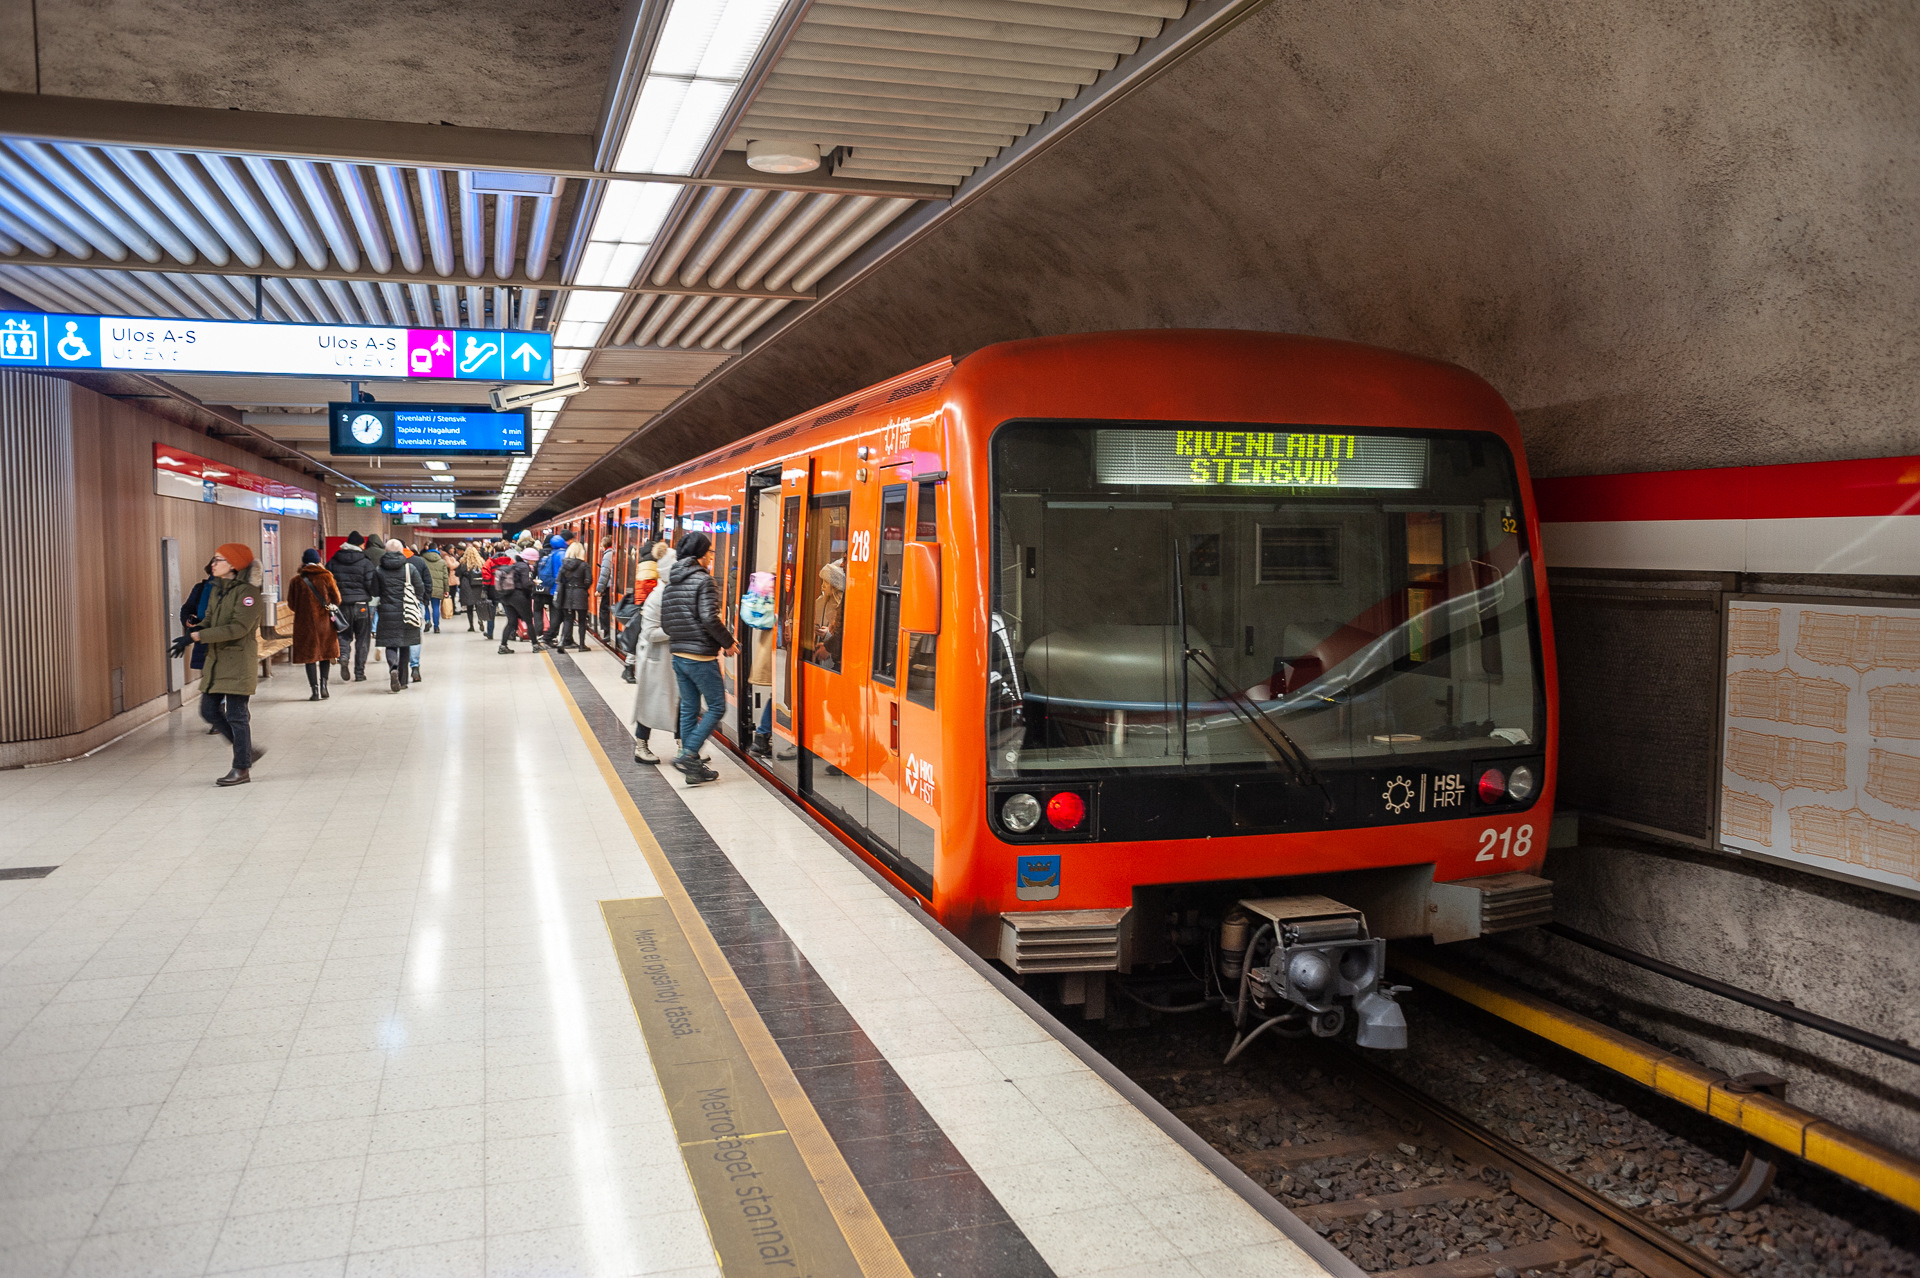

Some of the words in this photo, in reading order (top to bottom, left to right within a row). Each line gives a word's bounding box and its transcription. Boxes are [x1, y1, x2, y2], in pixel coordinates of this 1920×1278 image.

[112, 328, 155, 342] Ulos
[162, 330, 197, 344] A-S
[318, 335, 358, 350] Ulos
[365, 337, 396, 351] A-S
[144, 347, 179, 362] Ext
[342, 414, 349, 422] 2
[397, 414, 431, 423] Kivenlahti
[437, 415, 467, 423] Stensvik
[900, 416, 911, 434] HSL
[397, 427, 422, 435] Tapiola
[427, 427, 461, 436] Hagalund
[397, 438, 432, 446] Kivenlahti
[437, 439, 467, 447] Stensvik
[899, 432, 911, 450] HRT
[1175, 430, 1356, 459] KIVENLAHTI
[1189, 459, 1339, 485] STENSVIK
[1501, 517, 1518, 534] 32
[851, 529, 871, 563] 218
[919, 759, 935, 786] HKL
[1433, 773, 1466, 792] HSL
[919, 779, 935, 806] HST
[1433, 790, 1466, 808] HRT
[1475, 823, 1534, 862] 218
[633, 928, 658, 953] Metro
[642, 954, 669, 963] ei
[641, 962, 685, 1005] pysähdy
[663, 1005, 702, 1040] tässä.
[696, 1086, 764, 1182] Metrotåget
[735, 1185, 796, 1267] stannar
